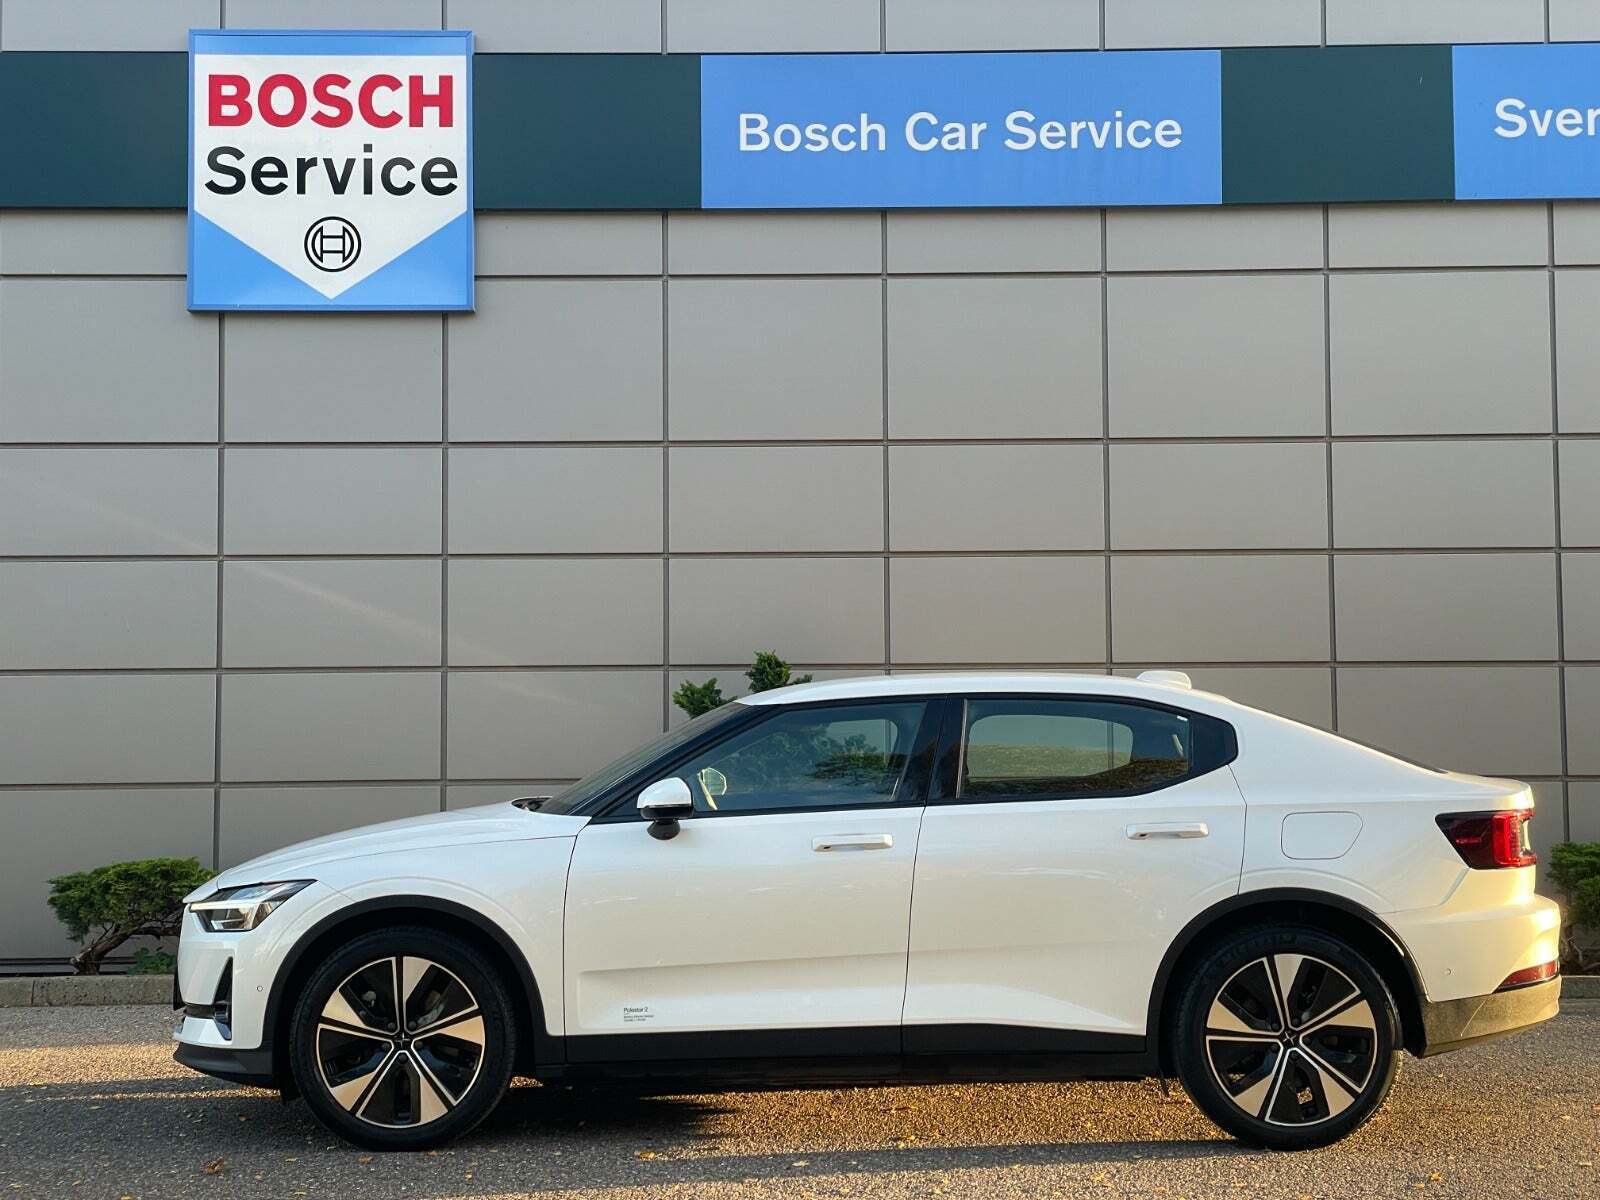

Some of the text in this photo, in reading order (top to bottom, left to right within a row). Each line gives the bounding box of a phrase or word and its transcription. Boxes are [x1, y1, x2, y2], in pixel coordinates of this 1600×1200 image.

[207, 73, 454, 129] BOSCH
[739, 109, 1182, 152] Bosch Car Service
[204, 143, 458, 197] Service
